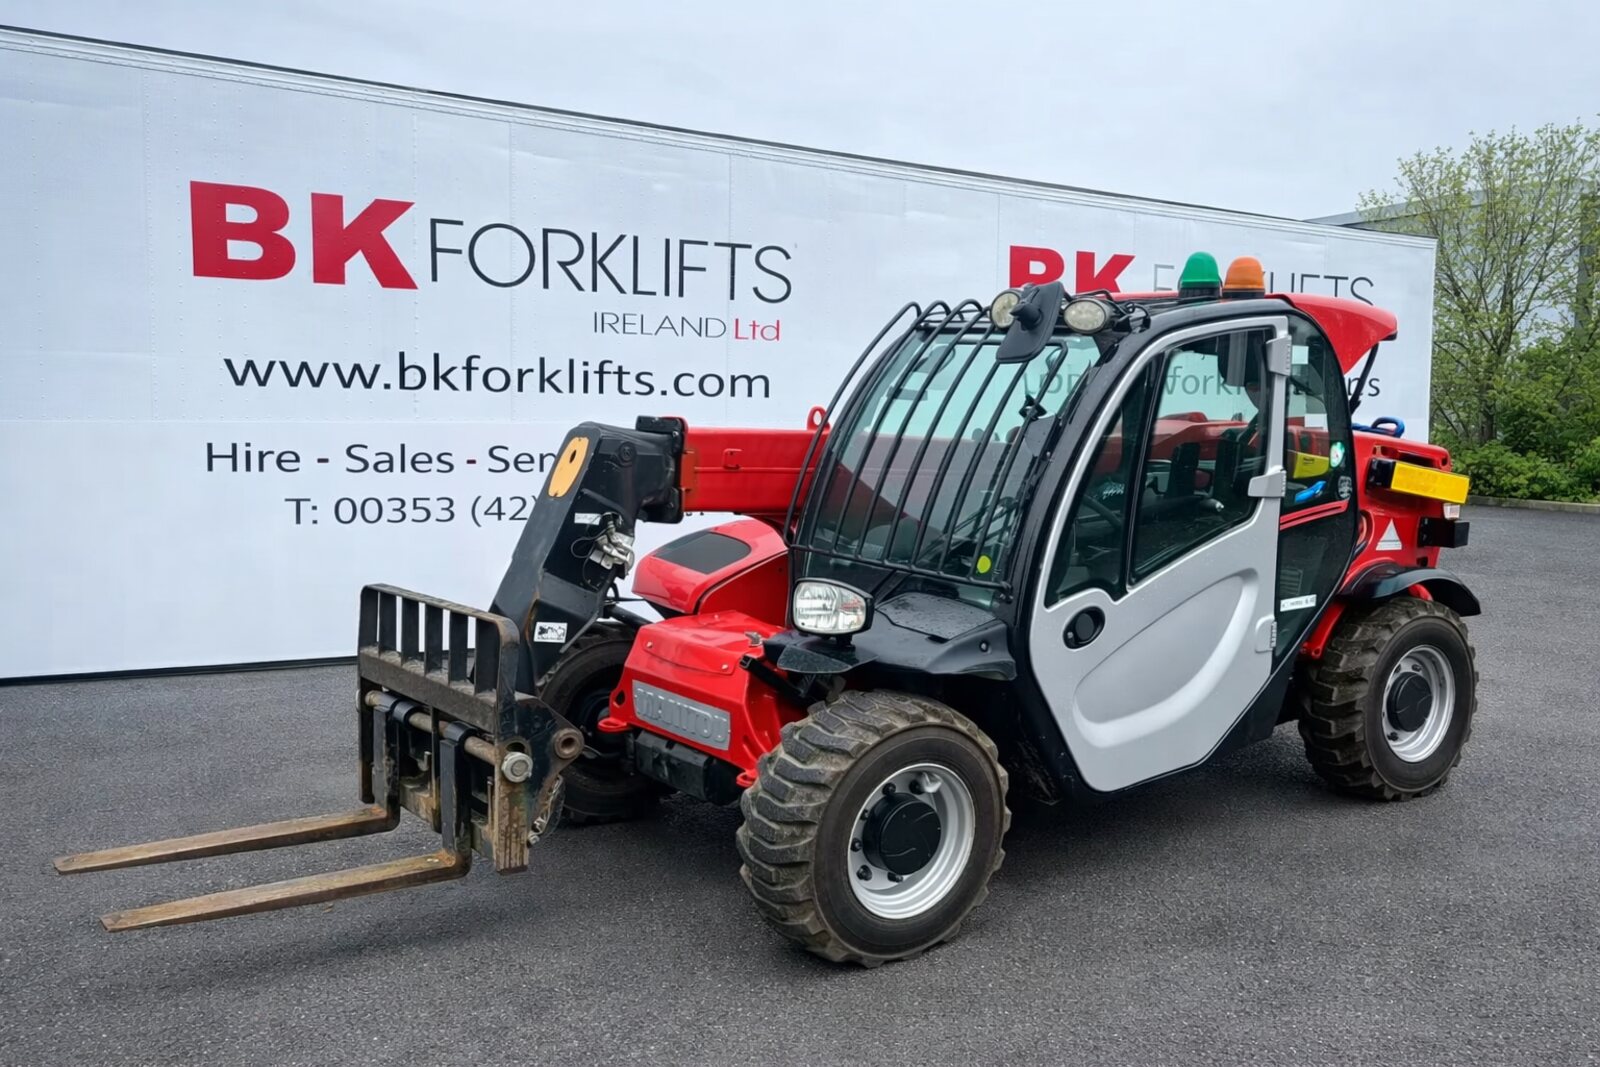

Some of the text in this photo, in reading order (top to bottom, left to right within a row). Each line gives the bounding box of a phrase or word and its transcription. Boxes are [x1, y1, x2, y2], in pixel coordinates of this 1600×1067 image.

[189, 180, 792, 304] BK FORKLIFTS
[594, 311, 780, 342] IRELAND Ltd
[223, 350, 770, 399] www.bkforklifts.com
[206, 442, 301, 473] Hire
[345, 443, 456, 474] Sales
[284, 497, 319, 525] T:
[333, 496, 456, 525] 00353
